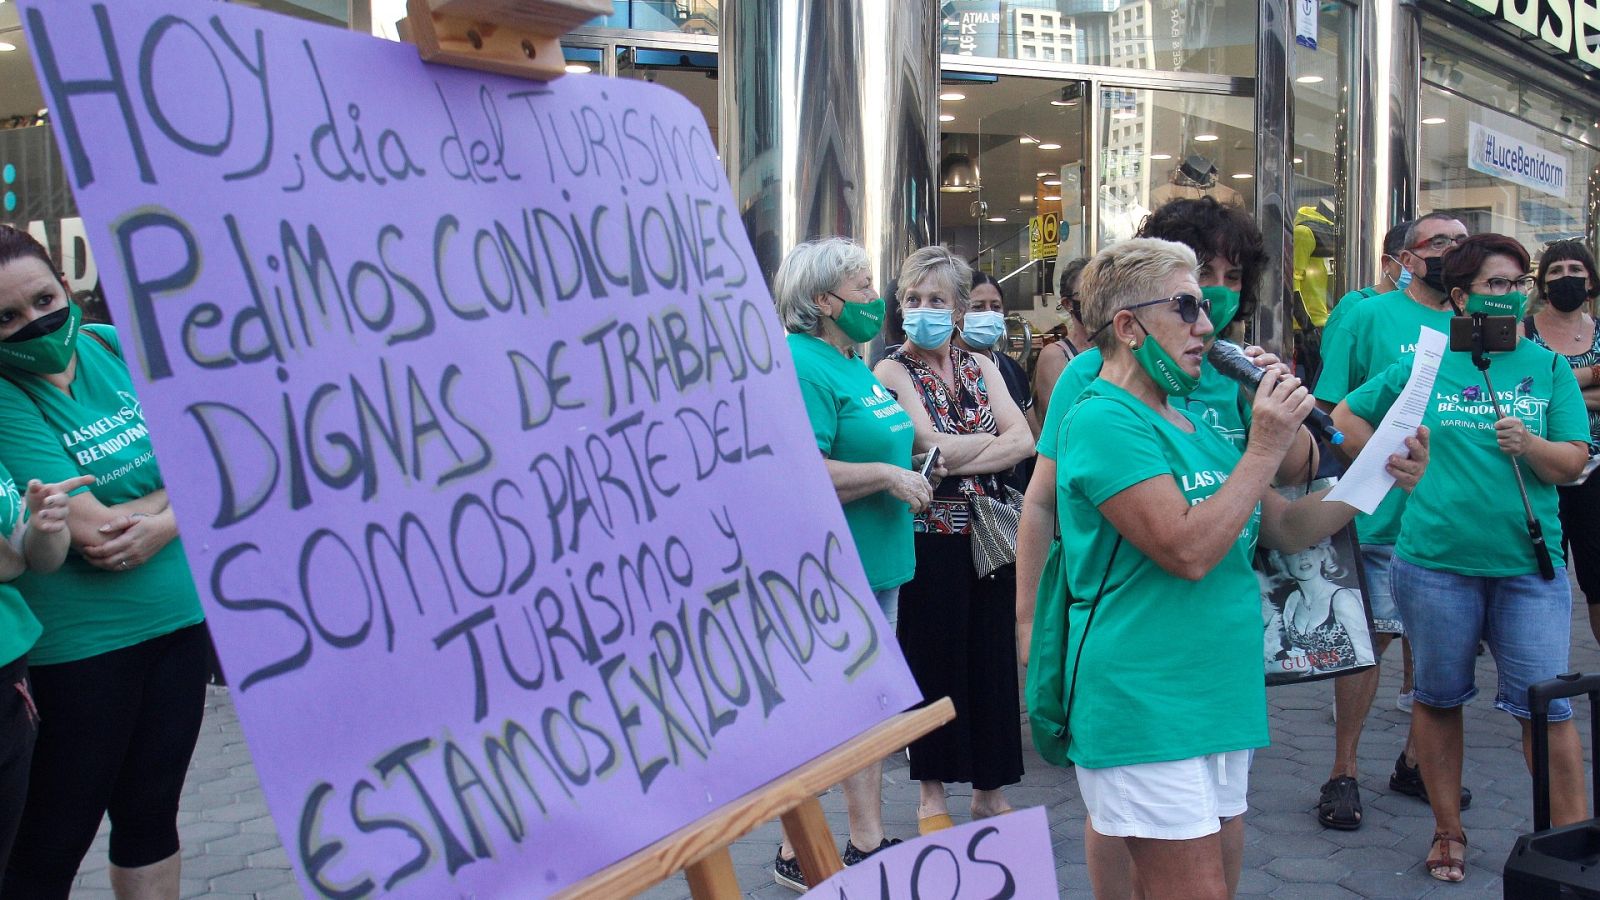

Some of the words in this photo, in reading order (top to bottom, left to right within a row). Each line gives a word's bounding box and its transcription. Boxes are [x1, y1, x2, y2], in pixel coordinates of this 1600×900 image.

[303, 40, 427, 186] dia
[435, 80, 521, 185] del
[1485, 133, 1563, 188] #LuceBenidorm
[507, 339, 585, 432] DE
[581, 293, 782, 417] TRABAJO.
[95, 462, 135, 487] MARINA
[134, 449, 154, 468] BAIX
[1440, 419, 1476, 429] MARINA
[1181, 470, 1216, 492] LAS
[211, 478, 537, 693] SOMOS
[528, 408, 681, 564] PARTE
[674, 386, 775, 482] DEL
[299, 691, 618, 900] ESTAMOS
[598, 530, 881, 795] EXPLOTAD@S
